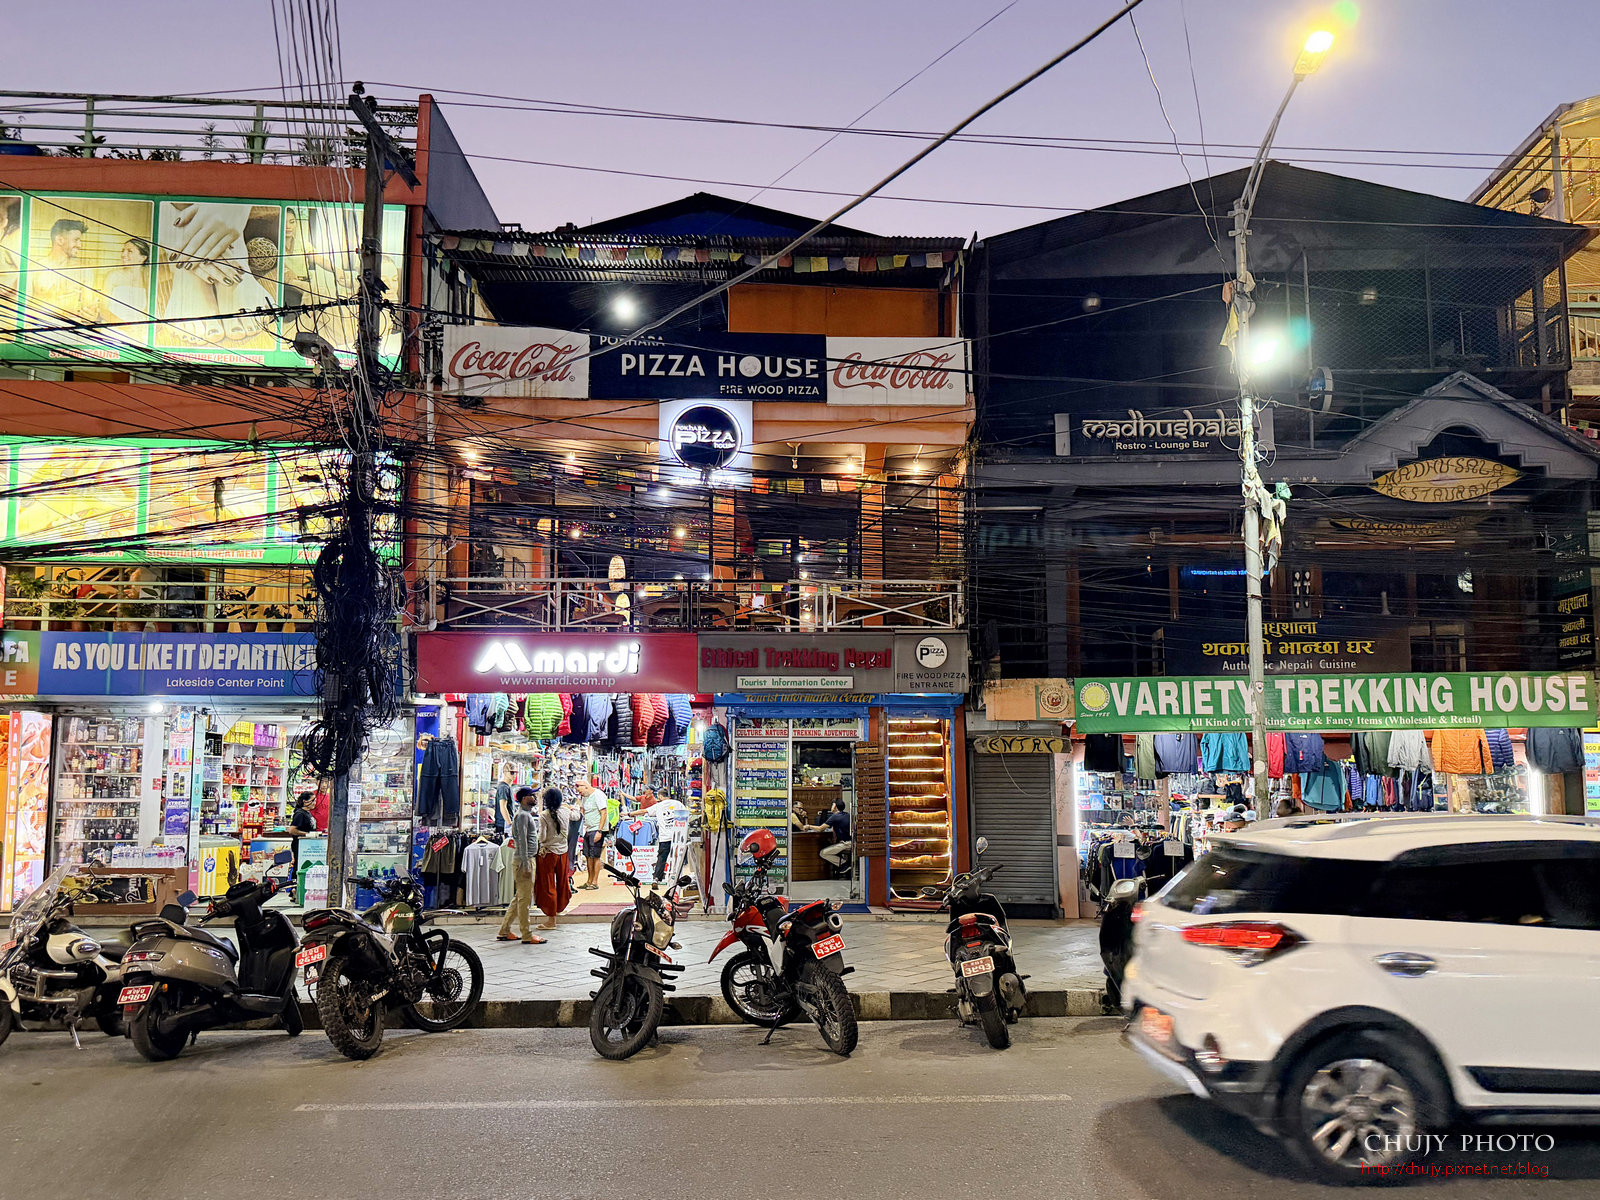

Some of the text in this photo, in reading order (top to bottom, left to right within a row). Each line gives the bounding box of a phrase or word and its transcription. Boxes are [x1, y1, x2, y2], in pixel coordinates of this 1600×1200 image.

[448, 341, 579, 382] Coca-Cola
[621, 354, 819, 378] PIZZA HOUSE
[720, 385, 819, 395] FIRE WOOD PIZZA
[1115, 441, 1147, 450] Restro
[1154, 440, 1191, 451] Lounge
[1192, 440, 1209, 449] Bar
[0, 641, 30, 663] PA
[1346, 640, 1375, 655] घर
[53, 642, 81, 670] AS
[84, 643, 125, 671] YOU
[127, 643, 173, 670] LIKE
[175, 643, 197, 670] IT
[701, 648, 758, 669] Ethical
[844, 648, 892, 670] Nepal
[1279, 659, 1313, 673] Nepali
[1319, 659, 1357, 669] Cuisine
[166, 677, 285, 687] Lakeside Center Point
[500, 675, 616, 687] www.mardi.com.np
[897, 672, 967, 680] FIRE WOOD PIZZA
[740, 678, 848, 687] Tourist Information Center
[909, 681, 954, 689] ENTRANCE
[745, 693, 876, 704] Tourist Information Center
[1110, 680, 1252, 716] VARIETY
[1275, 676, 1453, 713] TREKKING
[1470, 676, 1589, 711] HOUSE
[1188, 718, 1203, 727] All
[1205, 717, 1229, 727] Kind
[1230, 717, 1241, 727] of
[1287, 716, 1312, 726] Gear
[1314, 716, 1323, 725] &
[1326, 716, 1355, 727] Fancy
[1356, 716, 1383, 726] Items
[1385, 715, 1437, 727] (Wholesale
[1438, 716, 1448, 725] &
[1450, 715, 1482, 726] Retail)
[824, 729, 858, 737] ADVENTURE
[987, 737, 1056, 753] ENTRY
[736, 808, 786, 816] Guide/Porter
